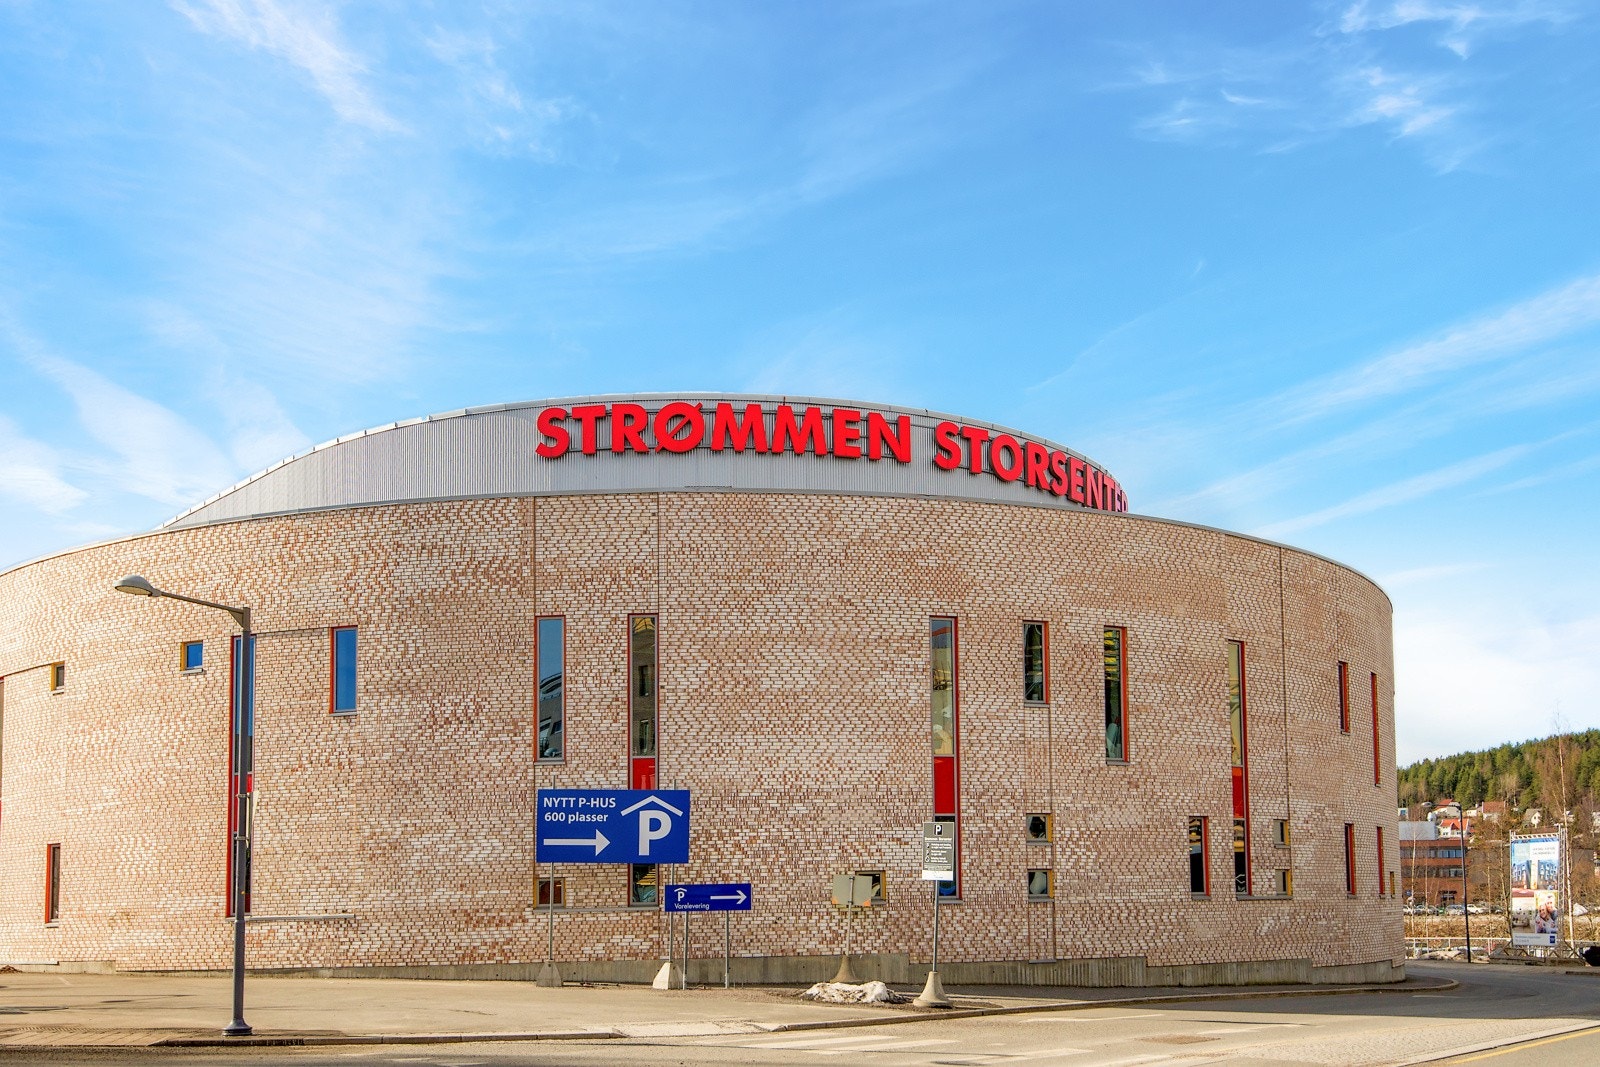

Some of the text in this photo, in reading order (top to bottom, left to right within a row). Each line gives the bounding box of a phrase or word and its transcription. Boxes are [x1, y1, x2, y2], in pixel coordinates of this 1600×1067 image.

[536, 402, 911, 462] STRØMMEN
[543, 797, 616, 808] NYTT P-HUS
[544, 811, 608, 824] 600 plasser
[638, 810, 672, 856] P
[677, 891, 685, 901] P
[674, 902, 710, 910] Varelevering
